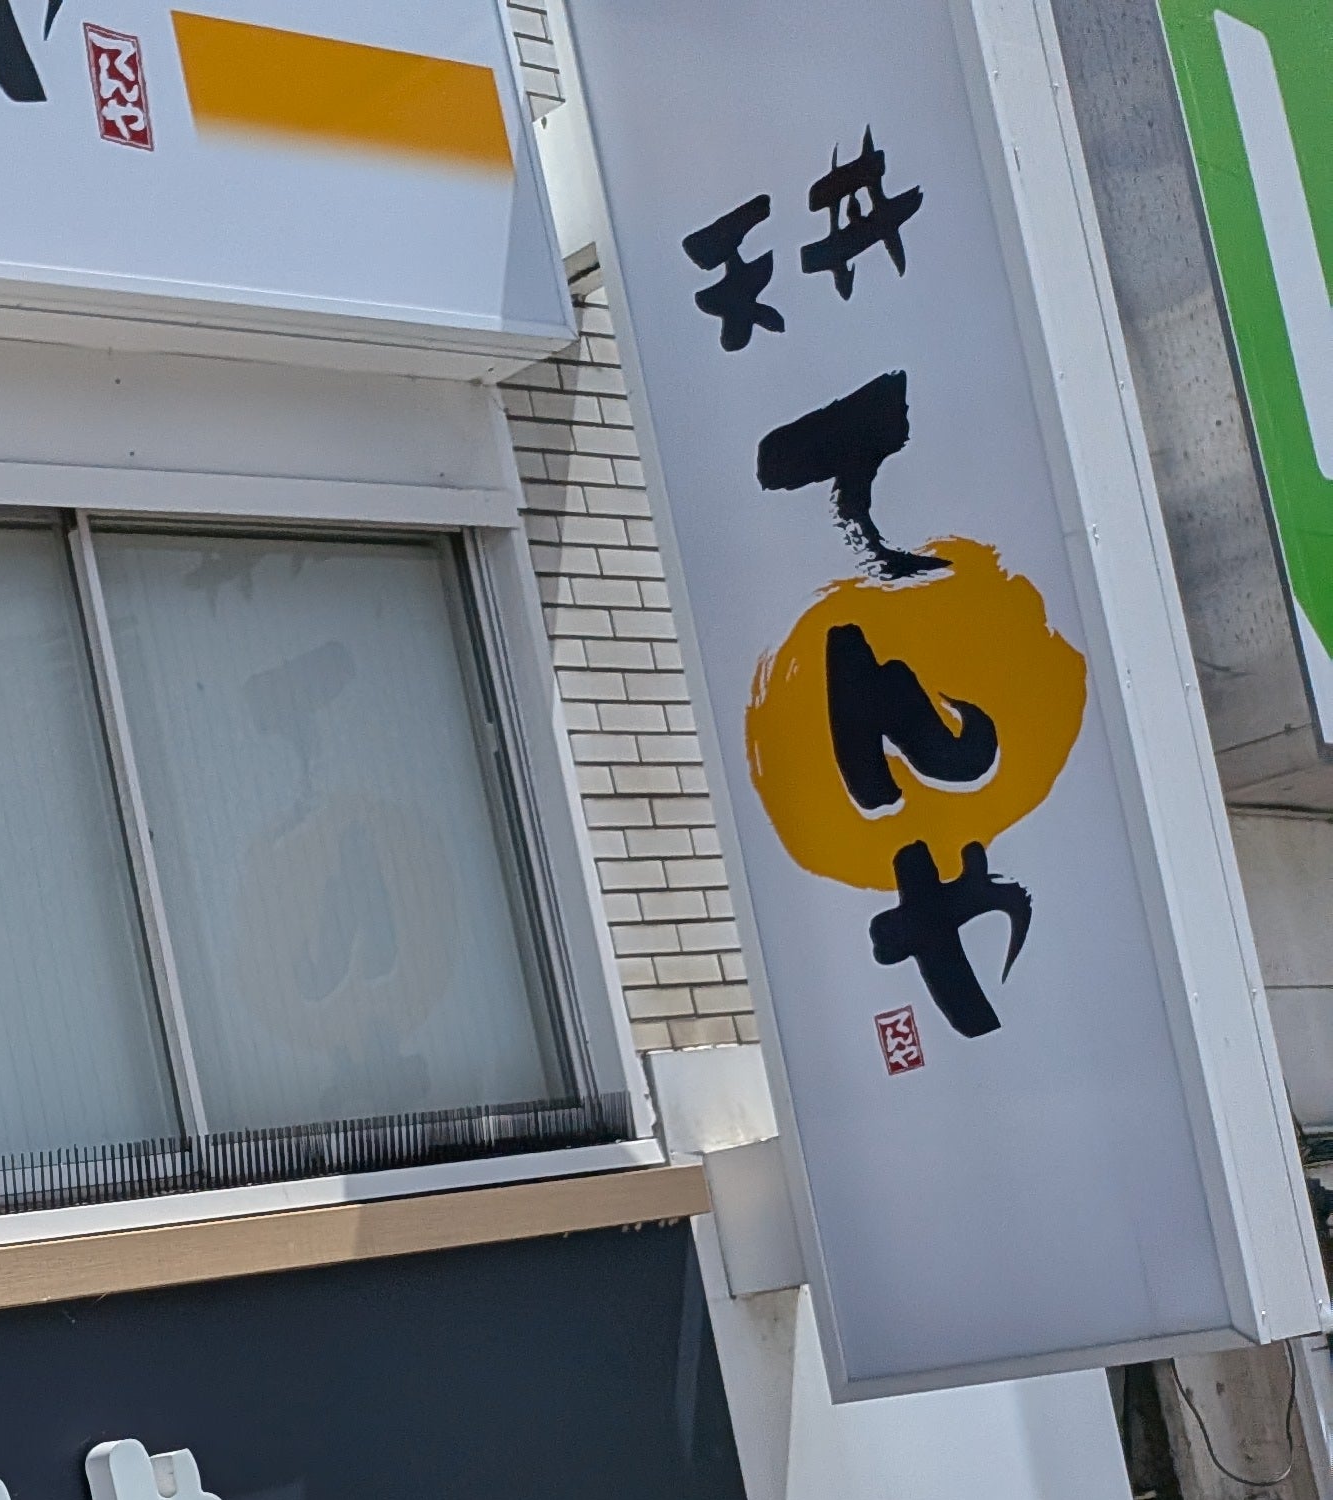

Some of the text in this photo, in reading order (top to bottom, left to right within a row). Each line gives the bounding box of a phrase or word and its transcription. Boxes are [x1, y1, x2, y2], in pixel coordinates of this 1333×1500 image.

[89, 29, 146, 142] てんや
[681, 122, 925, 353] 天丼
[755, 368, 1033, 1039] てんや
